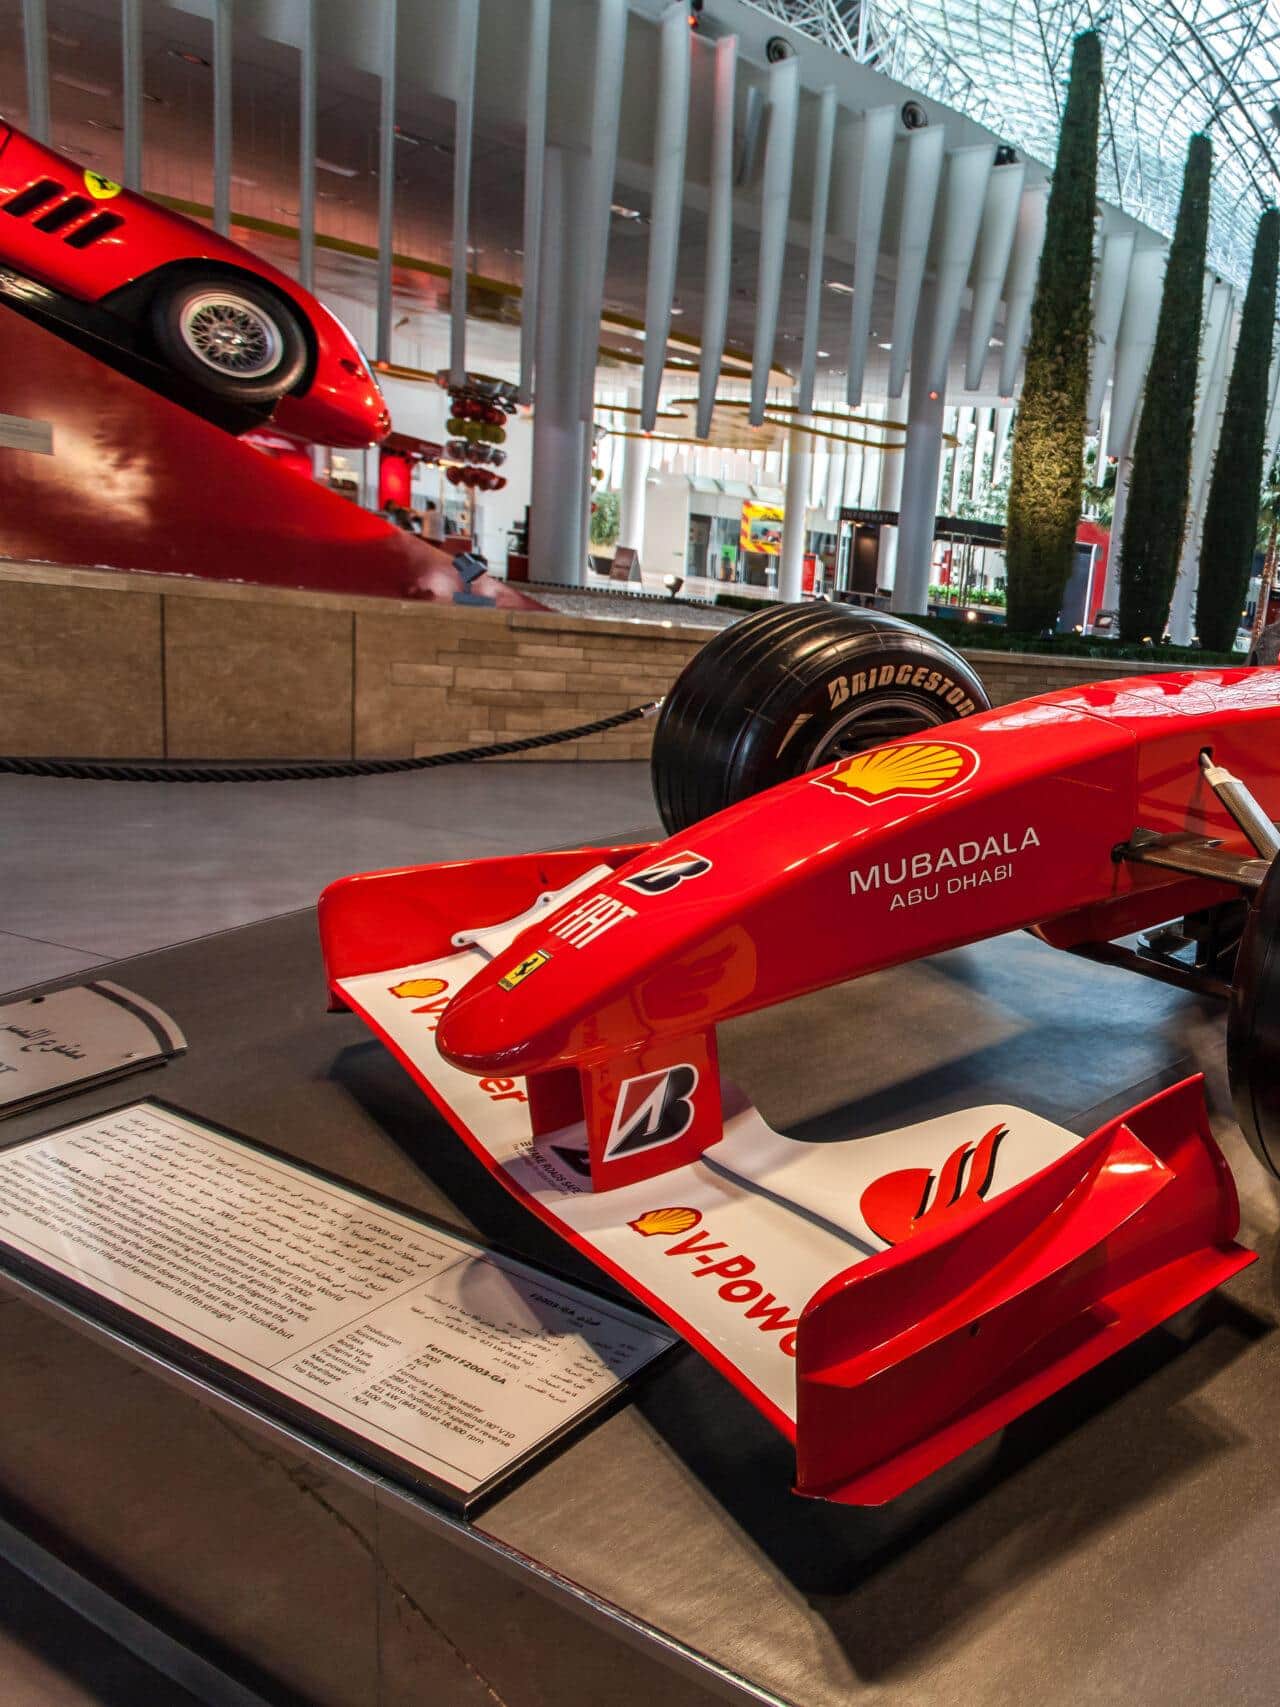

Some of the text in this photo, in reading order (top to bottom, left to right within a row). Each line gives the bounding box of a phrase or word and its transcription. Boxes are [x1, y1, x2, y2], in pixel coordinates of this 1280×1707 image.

[827, 664, 976, 718] BRIDGESTON
[849, 826, 1040, 895] MUBADALA
[889, 863, 1013, 912] ABU DHABI
[547, 893, 639, 950] FIAT
[140, 1247, 172, 1262] clutter
[165, 1261, 190, 1273] even
[187, 1272, 211, 1283] more
[207, 1281, 228, 1291] and
[233, 1294, 255, 1305] fine
[250, 1302, 275, 1315] tune
[270, 1313, 290, 1323] the
[151, 1242, 172, 1251] get
[166, 1248, 185, 1257] the
[179, 1255, 202, 1266] best
[197, 1264, 217, 1273] out
[221, 1275, 240, 1285] the
[233, 1283, 290, 1311] Bridgestone
[156, 1233, 196, 1252] lowering
[199, 1253, 218, 1262] the
[213, 1260, 244, 1275] center
[279, 1292, 299, 1302] The
[294, 1301, 316, 1312] rear
[170, 1227, 188, 1235] the
[195, 1240, 214, 1249] was
[210, 1247, 230, 1256] the
[224, 1255, 249, 1267] same
[256, 1269, 272, 1277] for
[268, 1275, 288, 1285] the
[219, 1240, 251, 1255] Ferrari
[254, 1257, 277, 1268] take
[272, 1266, 295, 1277] part
[299, 1278, 318, 1288] the
[314, 1286, 346, 1301] World
[112, 1257, 134, 1267] and
[128, 1265, 160, 1281] Ferrari
[153, 1279, 175, 1290] won
[171, 1287, 188, 1296] its
[182, 1293, 206, 1305] fifth
[198, 1302, 237, 1322] straight
[120, 1249, 142, 1260] that
[136, 1257, 162, 1270] went
[156, 1267, 184, 1281] down
[187, 1283, 208, 1293] the
[202, 1291, 223, 1301] last
[217, 1299, 239, 1310] race
[245, 1313, 280, 1331] Suzuka
[275, 1328, 296, 1339] but
[664, 1230, 797, 1357] V-Pow
[344, 1333, 366, 1345] Class
[352, 1329, 432, 1368] Successor N/A
[361, 1324, 404, 1345] Production
[425, 1343, 508, 1384] Ferrari F2003-GA
[289, 1364, 371, 1406] Top Speed N/A
[299, 1358, 343, 1381] Wheelbase
[360, 1389, 382, 1401] 3100
[308, 1353, 328, 1364] Max
[323, 1362, 350, 1376] power
[368, 1384, 386, 1393] 621
[397, 1398, 418, 1410] (845
[414, 1407, 433, 1418] hp)
[465, 1434, 485, 1445] rpm
[318, 1348, 368, 1374] Transmission
[441, 1411, 475, 1429] 7-speed
[478, 1430, 511, 1447] reverse
[325, 1343, 356, 1359] Engine
[351, 1356, 372, 1367] Type
[417, 1390, 439, 1401] rear,
[435, 1398, 487, 1424] longitudinal
[496, 1428, 516, 1439] V10
[334, 1338, 358, 1350] Body
[353, 1347, 375, 1359] style
[395, 1368, 430, 1386] Formula
[431, 1386, 485, 1414] single-seater
